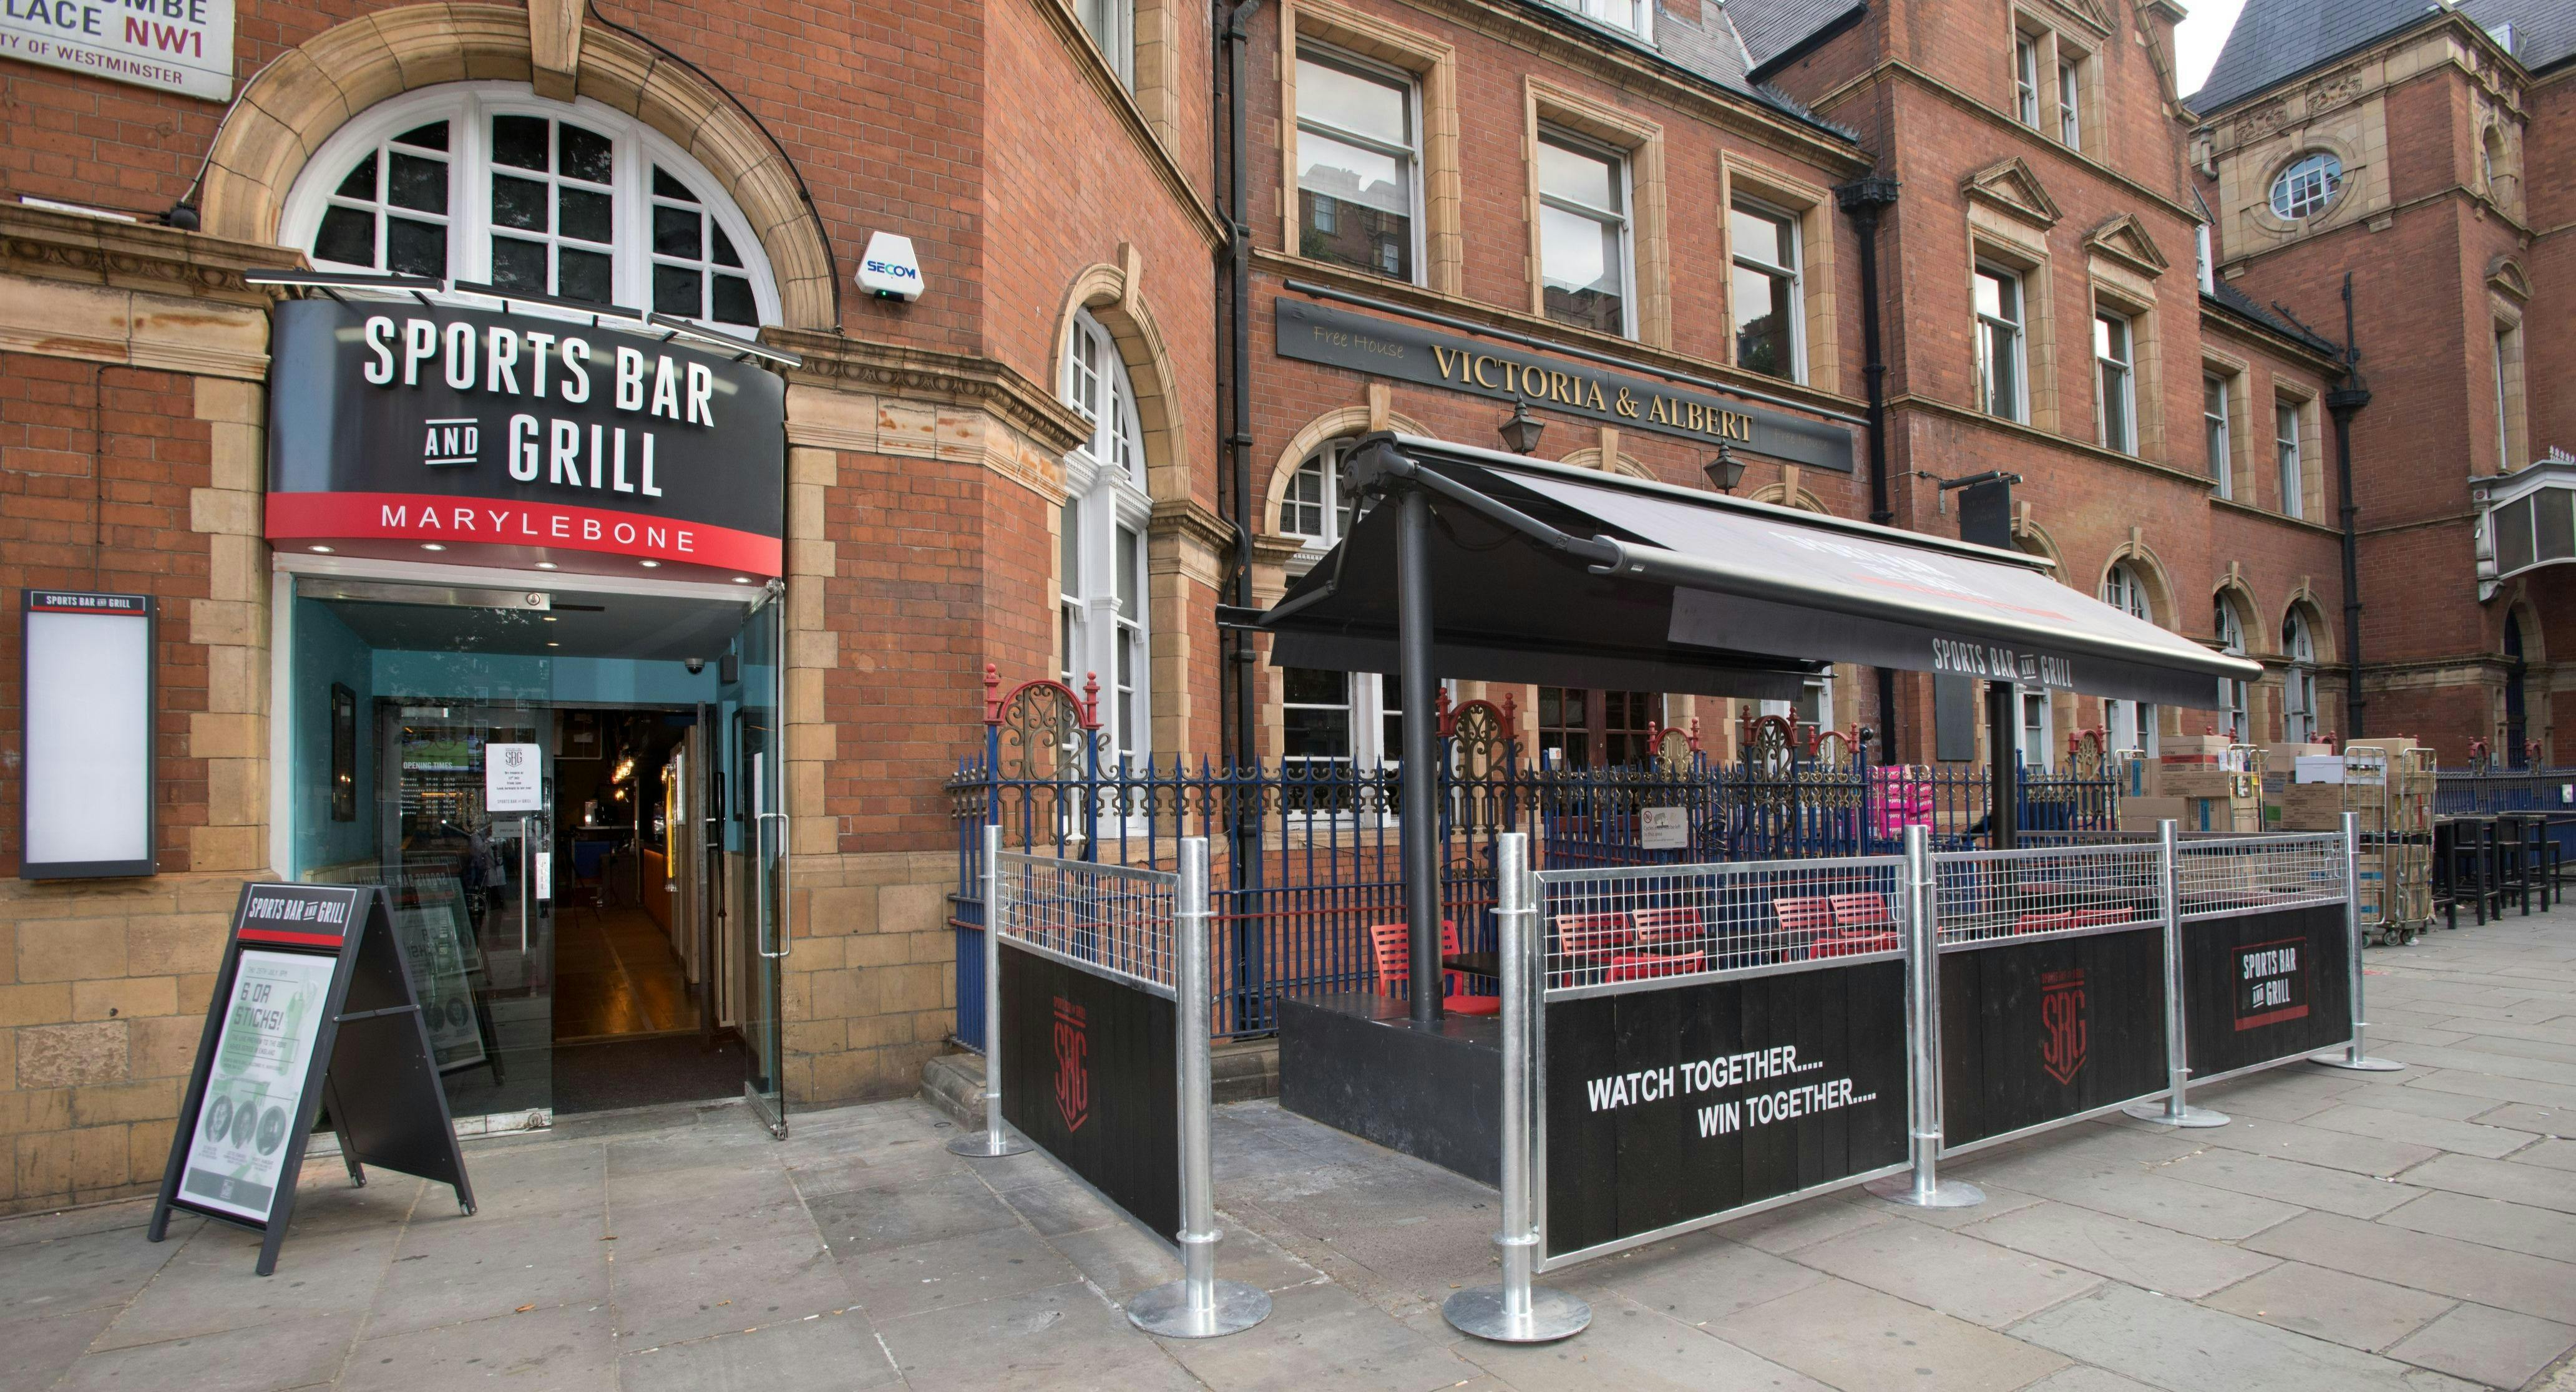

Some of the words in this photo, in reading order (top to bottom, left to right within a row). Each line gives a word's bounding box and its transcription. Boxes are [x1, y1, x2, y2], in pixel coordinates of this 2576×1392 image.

[6, 0, 102, 36] LACE
[125, 16, 201, 58] NW1
[29, 39, 50, 55] OF
[57, 45, 182, 84] WESTMINSTER
[867, 260, 915, 280] SECOM
[1314, 326, 1348, 347] Free
[1355, 334, 1404, 358] House
[364, 316, 591, 404] SPORTS
[616, 346, 715, 427] BAR
[1431, 344, 1607, 412] VICTORIA
[1616, 387, 1639, 419] &
[1647, 394, 1754, 442] ALBERT
[425, 426, 479, 457] AND
[509, 414, 663, 497] GRILL
[381, 505, 695, 553] MARYLEBONE
[46, 595, 77, 605] SPORTS
[79, 596, 95, 606] BAR
[109, 598, 130, 608] GRILL
[1933, 638, 1986, 674] SPORTS
[1989, 647, 2017, 679] BAR
[2021, 659, 2036, 675] AND
[2040, 656, 2072, 687] GRILL
[403, 761, 432, 769] OPENING
[434, 761, 453, 769] TIMES
[249, 897, 285, 920] SPORTS
[283, 900, 305, 920] BAR
[304, 905, 318, 917] AND
[317, 902, 345, 923] GRILL
[2243, 950, 2277, 979] SPORTS
[2279, 948, 2296, 973] BAR
[241, 982, 251, 1001] 6
[252, 983, 271, 1003] OR
[2253, 987, 2264, 1005] AND
[2266, 978, 2290, 1006] GRILL
[234, 1006, 284, 1031] STICKS!
[2042, 989, 2086, 1075] SBG
[1054, 1021, 1088, 1121] SBG
[1587, 1066, 1674, 1112] WATCH
[1681, 1045, 1823, 1094] TOGETHER.....
[1698, 1101, 1740, 1138] WIN
[1746, 1078, 1876, 1127] TOGETHER.....
